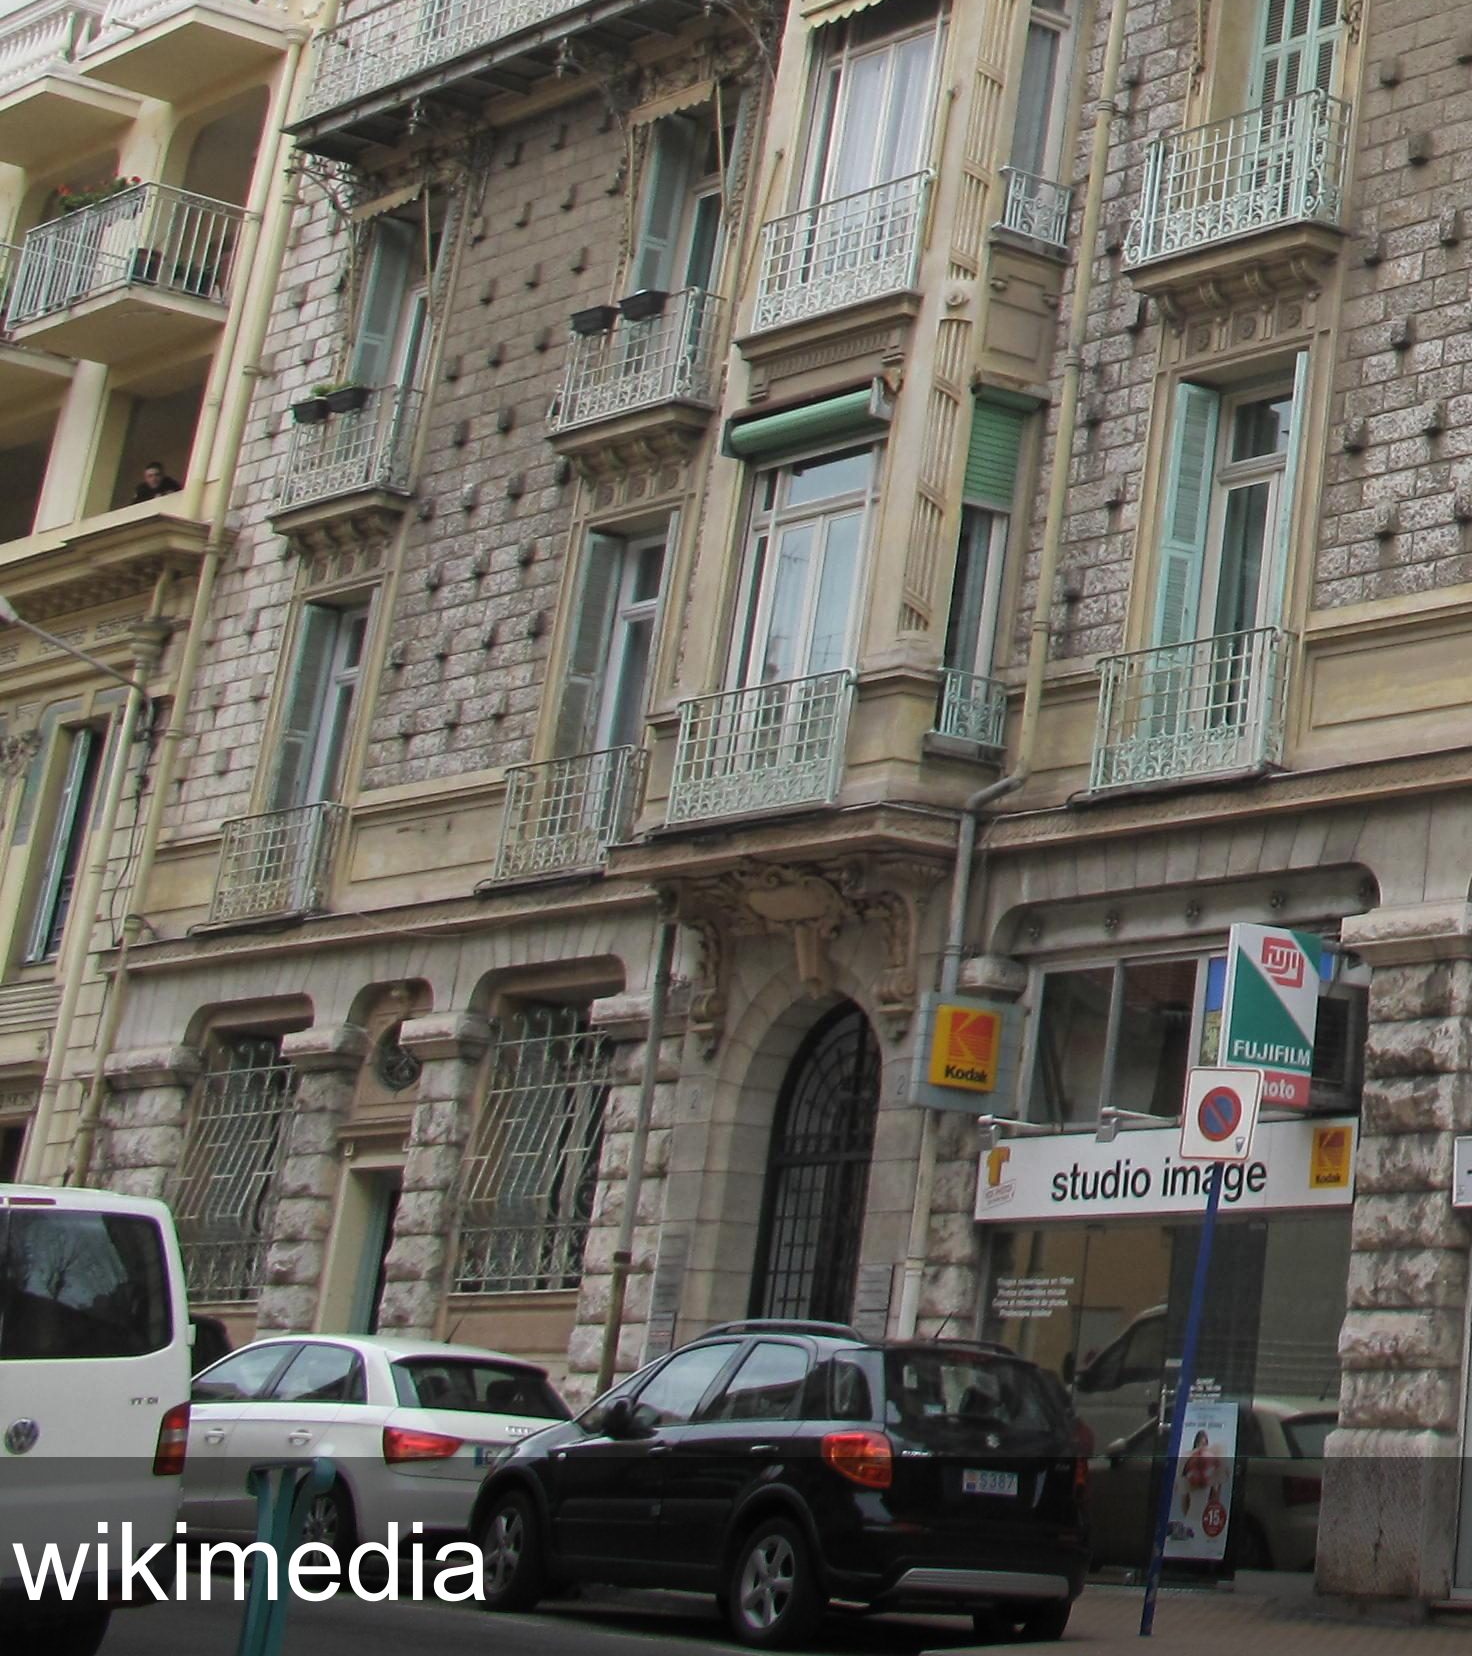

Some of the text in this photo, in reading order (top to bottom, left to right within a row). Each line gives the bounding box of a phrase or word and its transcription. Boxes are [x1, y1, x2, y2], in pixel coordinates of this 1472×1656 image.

[1233, 1039, 1311, 1067] FUJIFILM
[944, 1064, 988, 1084] Kodak
[1051, 1159, 1151, 1202] studio
[1162, 1157, 1267, 1202] image
[1315, 1173, 1342, 1184] Kodak
